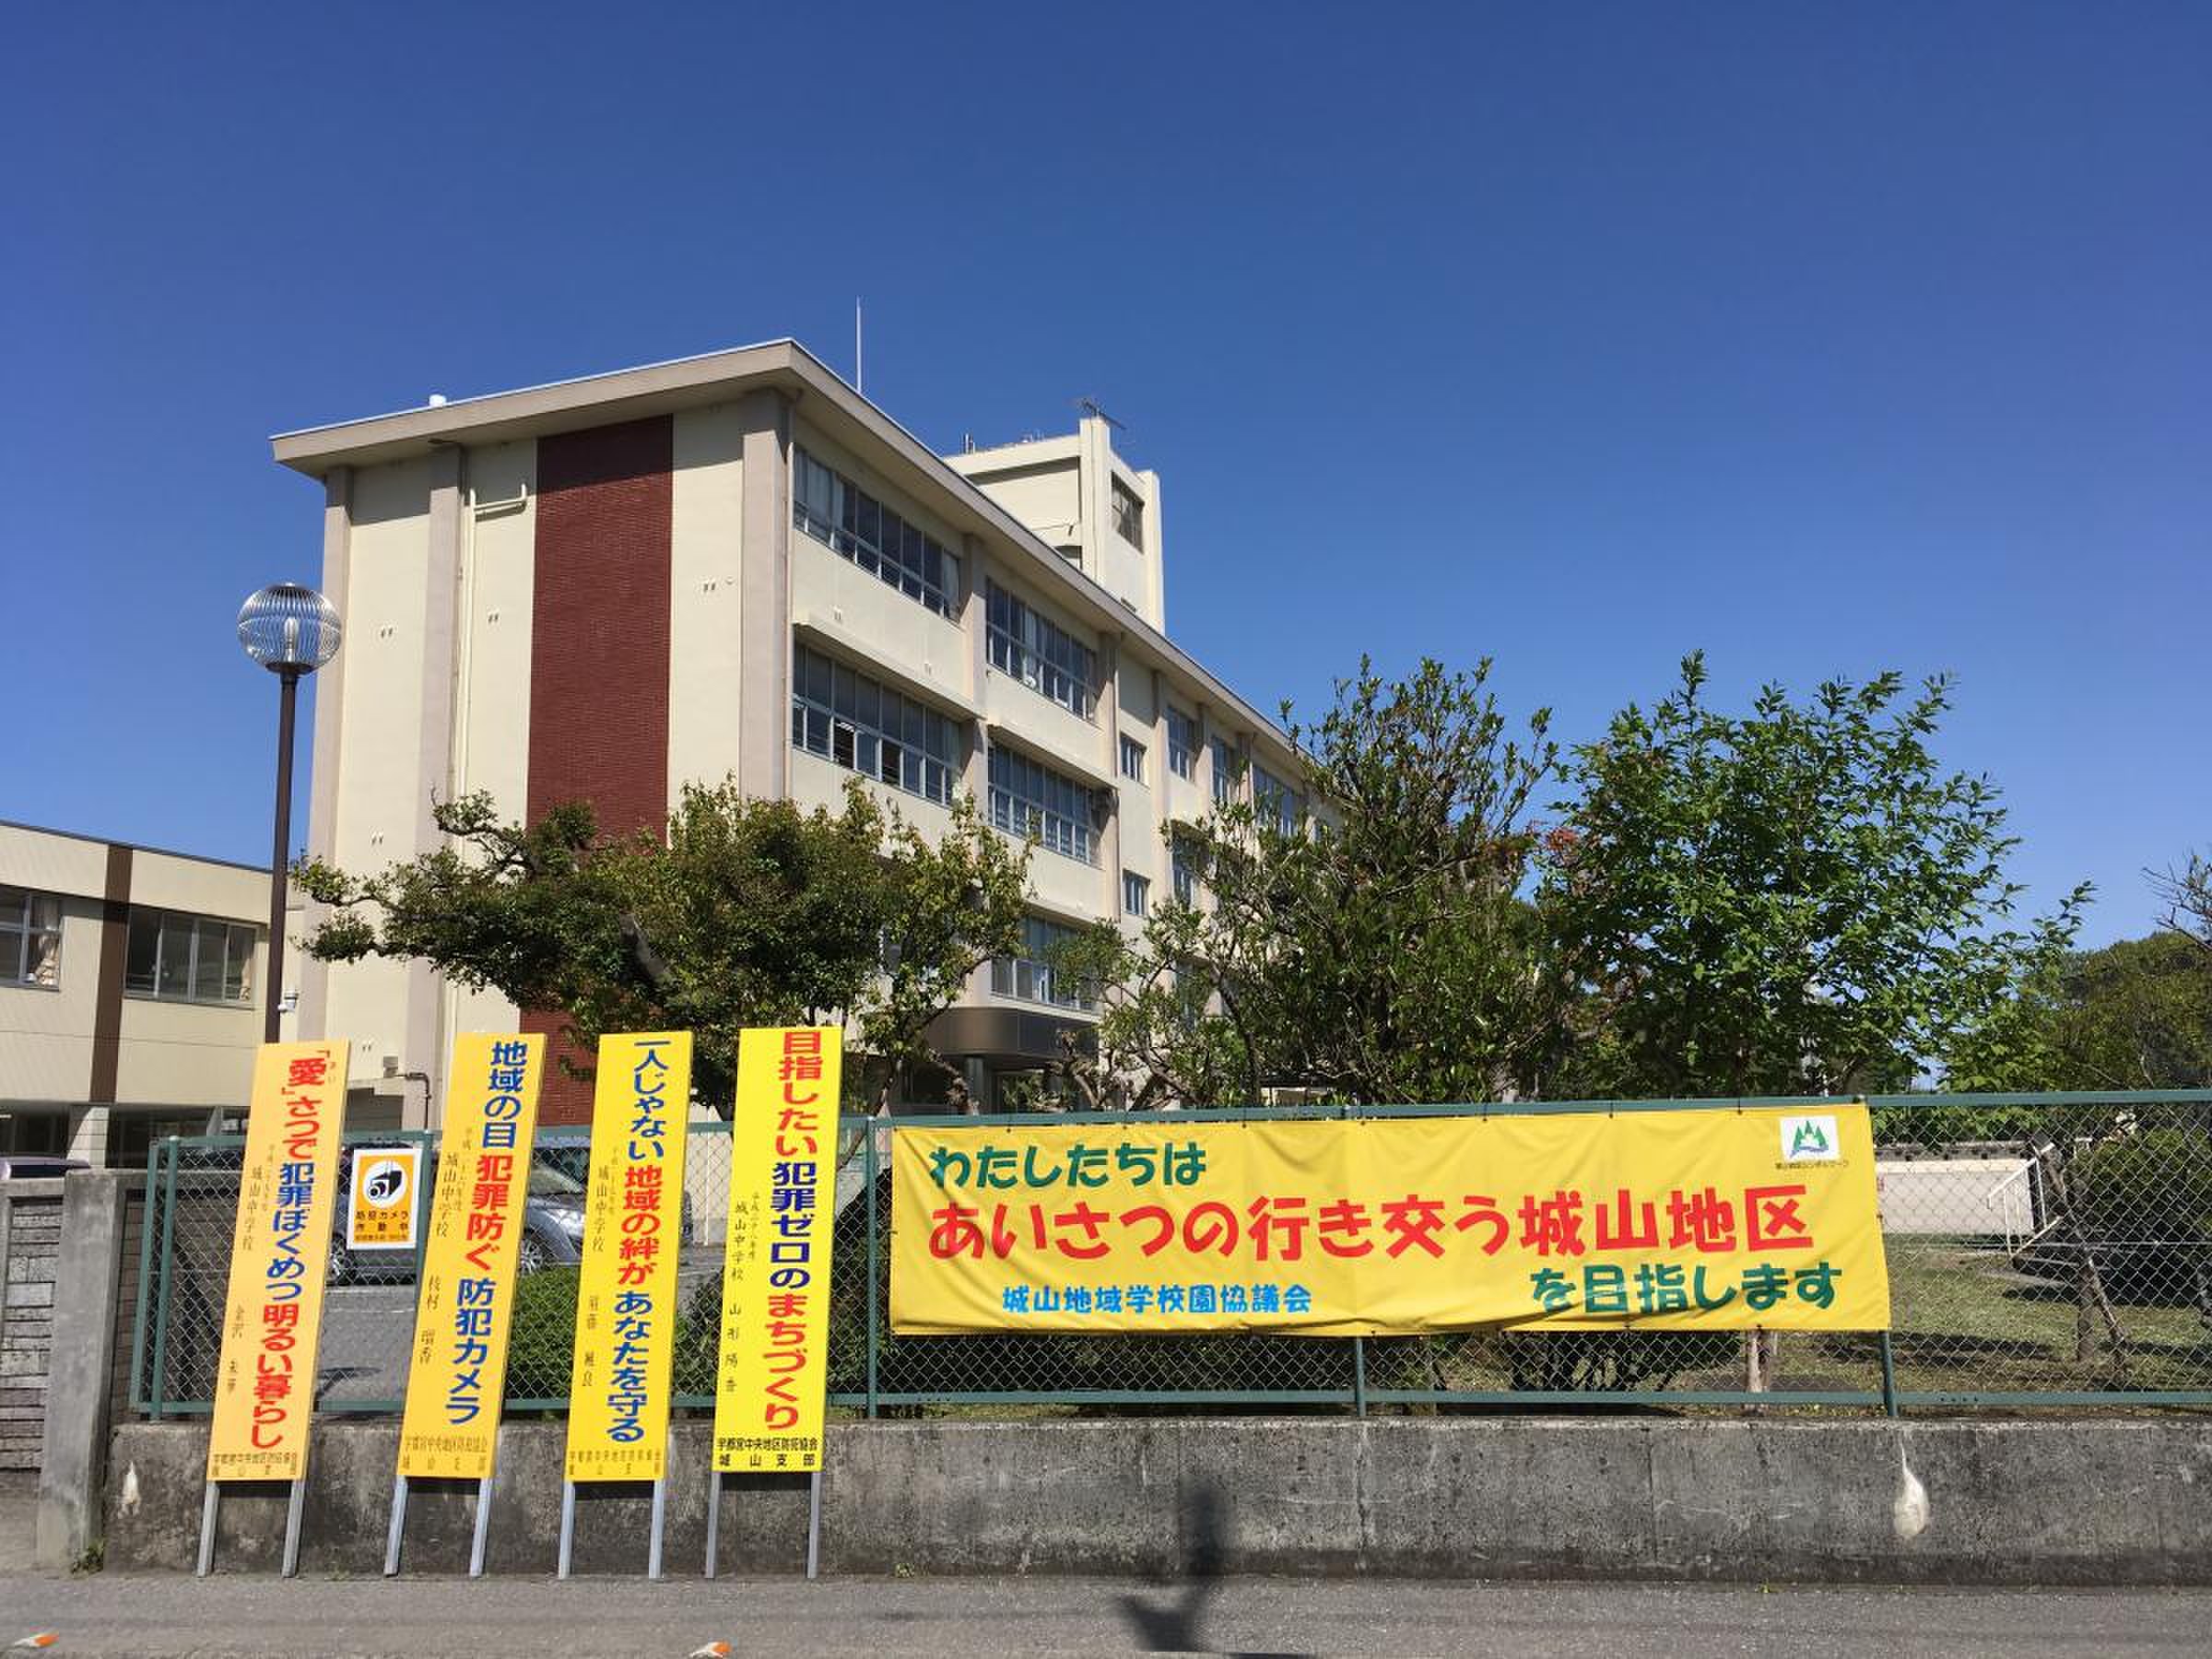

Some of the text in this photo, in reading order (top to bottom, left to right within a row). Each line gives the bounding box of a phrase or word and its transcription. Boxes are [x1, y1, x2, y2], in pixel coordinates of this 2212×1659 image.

[928, 1141, 1206, 1189] わたしたちは
[928, 1184, 1814, 1262] あいさつの行き交う城山地区
[1003, 1284, 1312, 1314] 城山地域学校園協議会
[1529, 1262, 1842, 1314] を目指します
